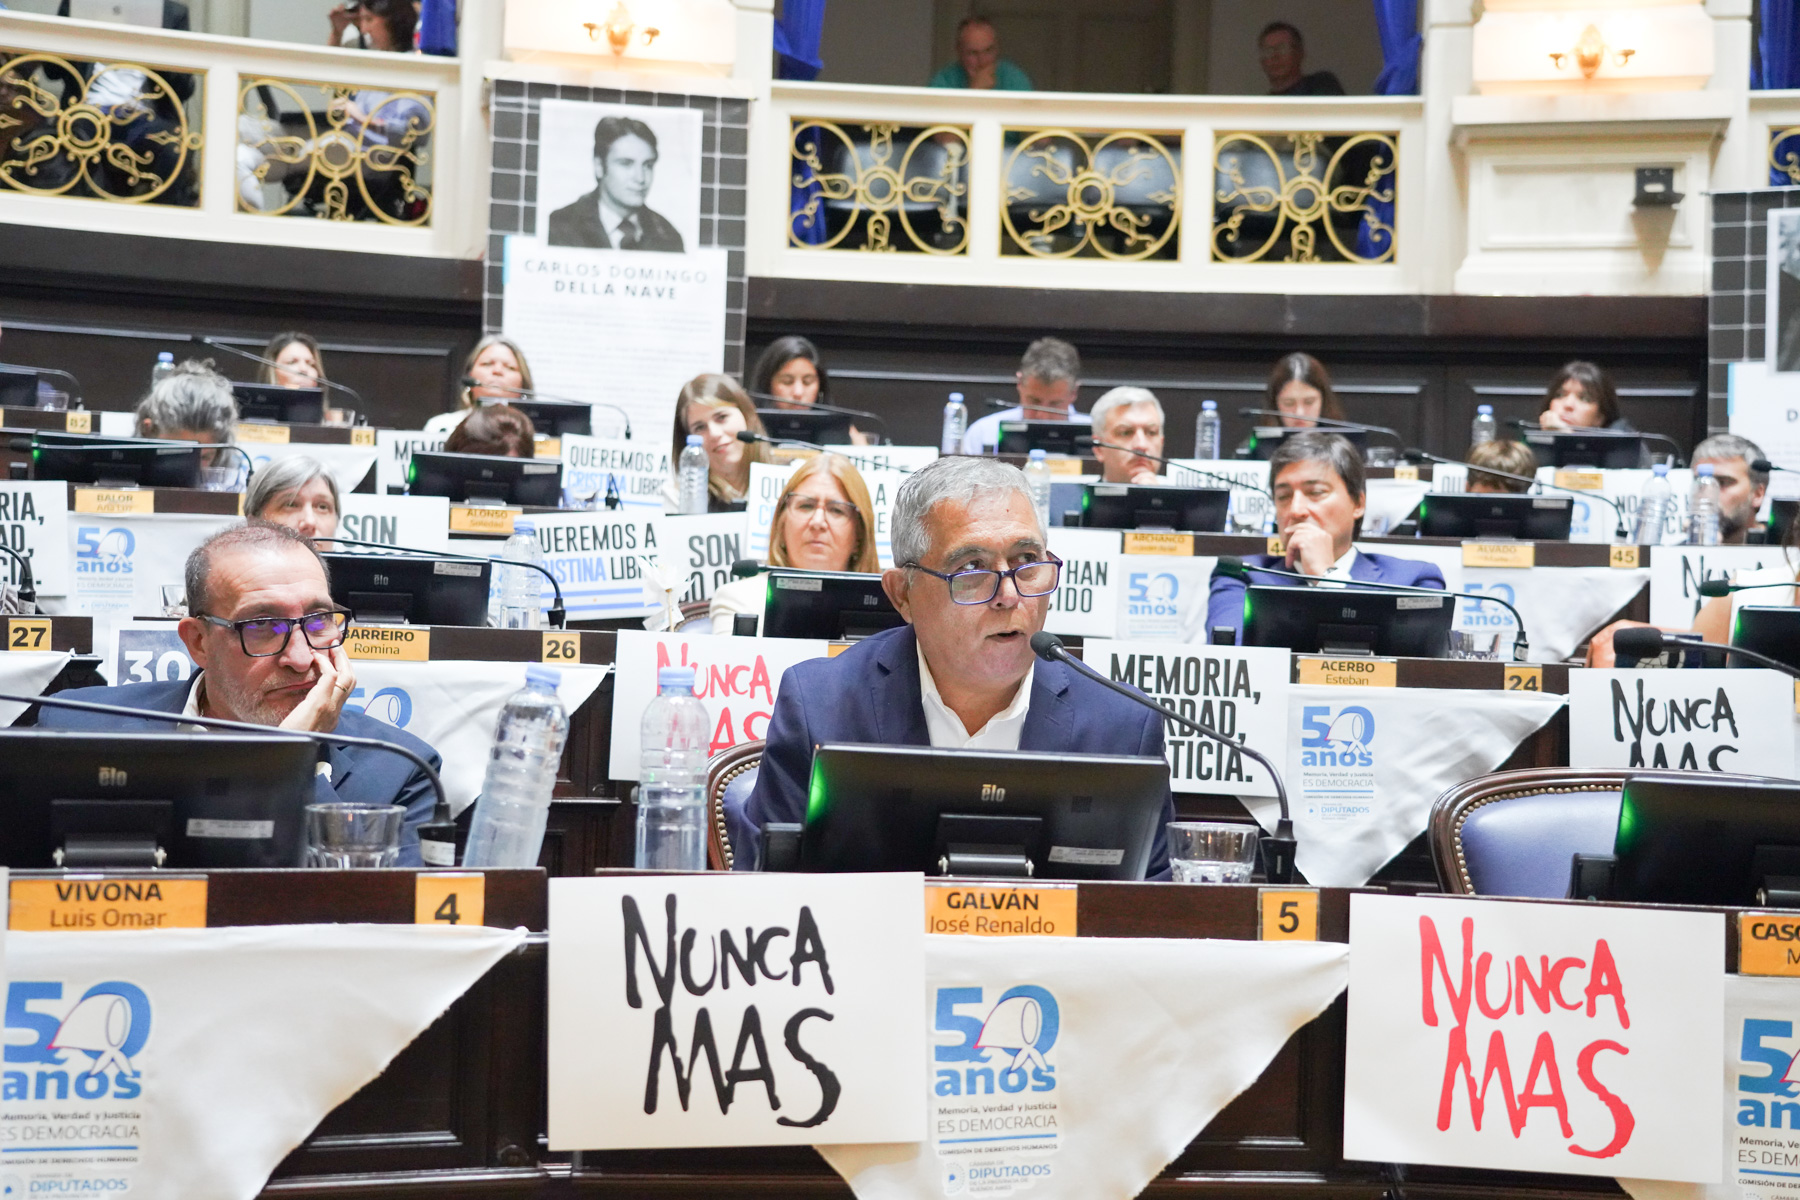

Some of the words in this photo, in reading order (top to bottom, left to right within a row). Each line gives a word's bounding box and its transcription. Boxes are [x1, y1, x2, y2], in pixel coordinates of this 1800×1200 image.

[524, 259, 600, 278] CARLOS
[609, 265, 708, 285] DOMINGO
[554, 279, 616, 296] DELLA
[624, 283, 677, 300] NAVE
[570, 445, 654, 473] QUEREMOS
[659, 454, 668, 473] A
[467, 508, 508, 519] ALONSO
[77, 527, 136, 558] 50
[342, 514, 397, 548] SON
[534, 523, 637, 554] UEREMOS
[644, 522, 658, 549] A
[688, 533, 741, 568] SON
[1612, 550, 1635, 564] 45
[530, 556, 607, 584] RISTINA
[1066, 560, 1108, 586] HAN
[1129, 572, 1179, 603] 50
[12, 627, 47, 647] 27
[354, 642, 400, 655] Romina
[545, 639, 576, 660] 26
[1110, 653, 1261, 705] MEMORIA,
[1320, 660, 1375, 673] ACERBO
[1325, 673, 1369, 686] Esteban
[1508, 675, 1540, 692] 24
[1154, 696, 1246, 746] RDAD,
[1611, 678, 1739, 742] NUNCA
[1301, 705, 1375, 749] 50
[1166, 739, 1253, 783] TICIA.
[1301, 744, 1374, 767] años
[1302, 779, 1314, 788] ES
[1315, 779, 1374, 788] DEMOCRACIA
[1321, 806, 1370, 814] DIPUTADOS
[55, 882, 163, 901] VIVONA
[946, 888, 1039, 911] GALVÁN
[50, 908, 96, 928] Luis
[102, 908, 167, 928] Omar
[434, 893, 461, 925] 4
[1278, 901, 1299, 933] 5
[930, 915, 969, 933] José
[975, 915, 1055, 934] Renaldo
[621, 893, 835, 1008] NUNCA
[1418, 915, 1630, 1030] NUNCA
[3, 980, 152, 1065] 50
[934, 984, 1060, 1062] 50
[643, 1004, 842, 1128] MAS
[1738, 1018, 1796, 1095] 5
[2, 1063, 142, 1100] años
[934, 1058, 1057, 1097] años
[1436, 1025, 1635, 1159] MAS
[938, 1106, 981, 1115] Memoria,
[982, 1104, 1014, 1113] Verdad
[1024, 1102, 1058, 1112] Justicia
[22, 1124, 140, 1140] DEMOCRACIA
[937, 1119, 955, 1133] ES
[959, 1114, 1058, 1133] DEMOCRACIA
[1739, 1136, 1785, 1149] Memoria,
[1738, 1149, 1757, 1163] ES
[1761, 1150, 1800, 1167] DEM
[968, 1164, 1051, 1180] DIPUTADOS
[1738, 1178, 1775, 1188] COMISIÓN
[30, 1178, 128, 1193] DIPUTADOS
